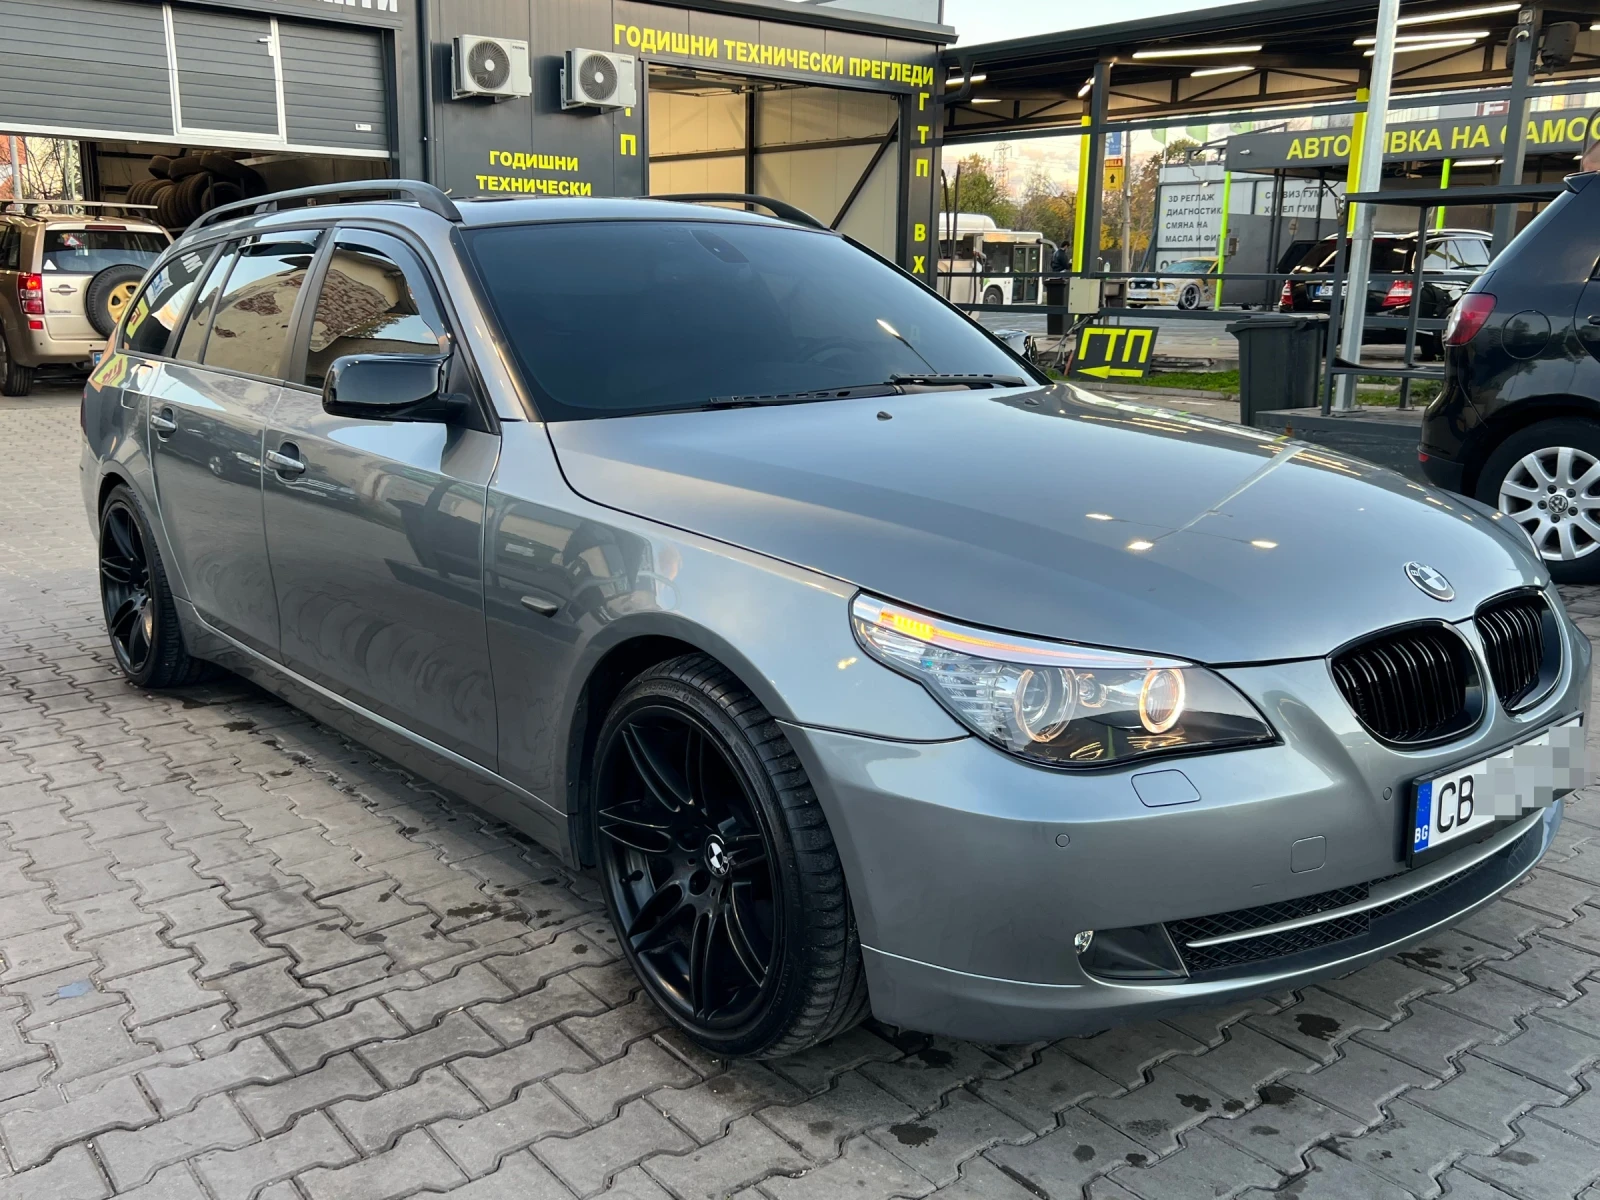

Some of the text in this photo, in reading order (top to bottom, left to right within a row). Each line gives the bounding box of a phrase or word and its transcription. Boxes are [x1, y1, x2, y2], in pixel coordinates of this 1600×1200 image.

[614, 23, 934, 87] ГОДИШНИ ТЕХНИЧЕСКИ ПРЕГЛЕДИ
[1286, 128, 1443, 160] АВТОВКА
[1451, 124, 1490, 150] НА
[489, 150, 579, 171] ГОДИШНИ
[475, 175, 592, 196] ТЕХНИЧЕСКИ
[1168, 193, 1215, 203] 3D РЕГЛАЖ
[1166, 207, 1223, 216] ДИАГНОСТИК
[1165, 221, 1208, 229] СМЯНА НА
[1165, 235, 1192, 243] МАСЛА
[1196, 234, 1201, 242] И
[1078, 327, 1153, 363] ГТП
[1436, 774, 1475, 834] CB
[1414, 824, 1429, 843] BG
